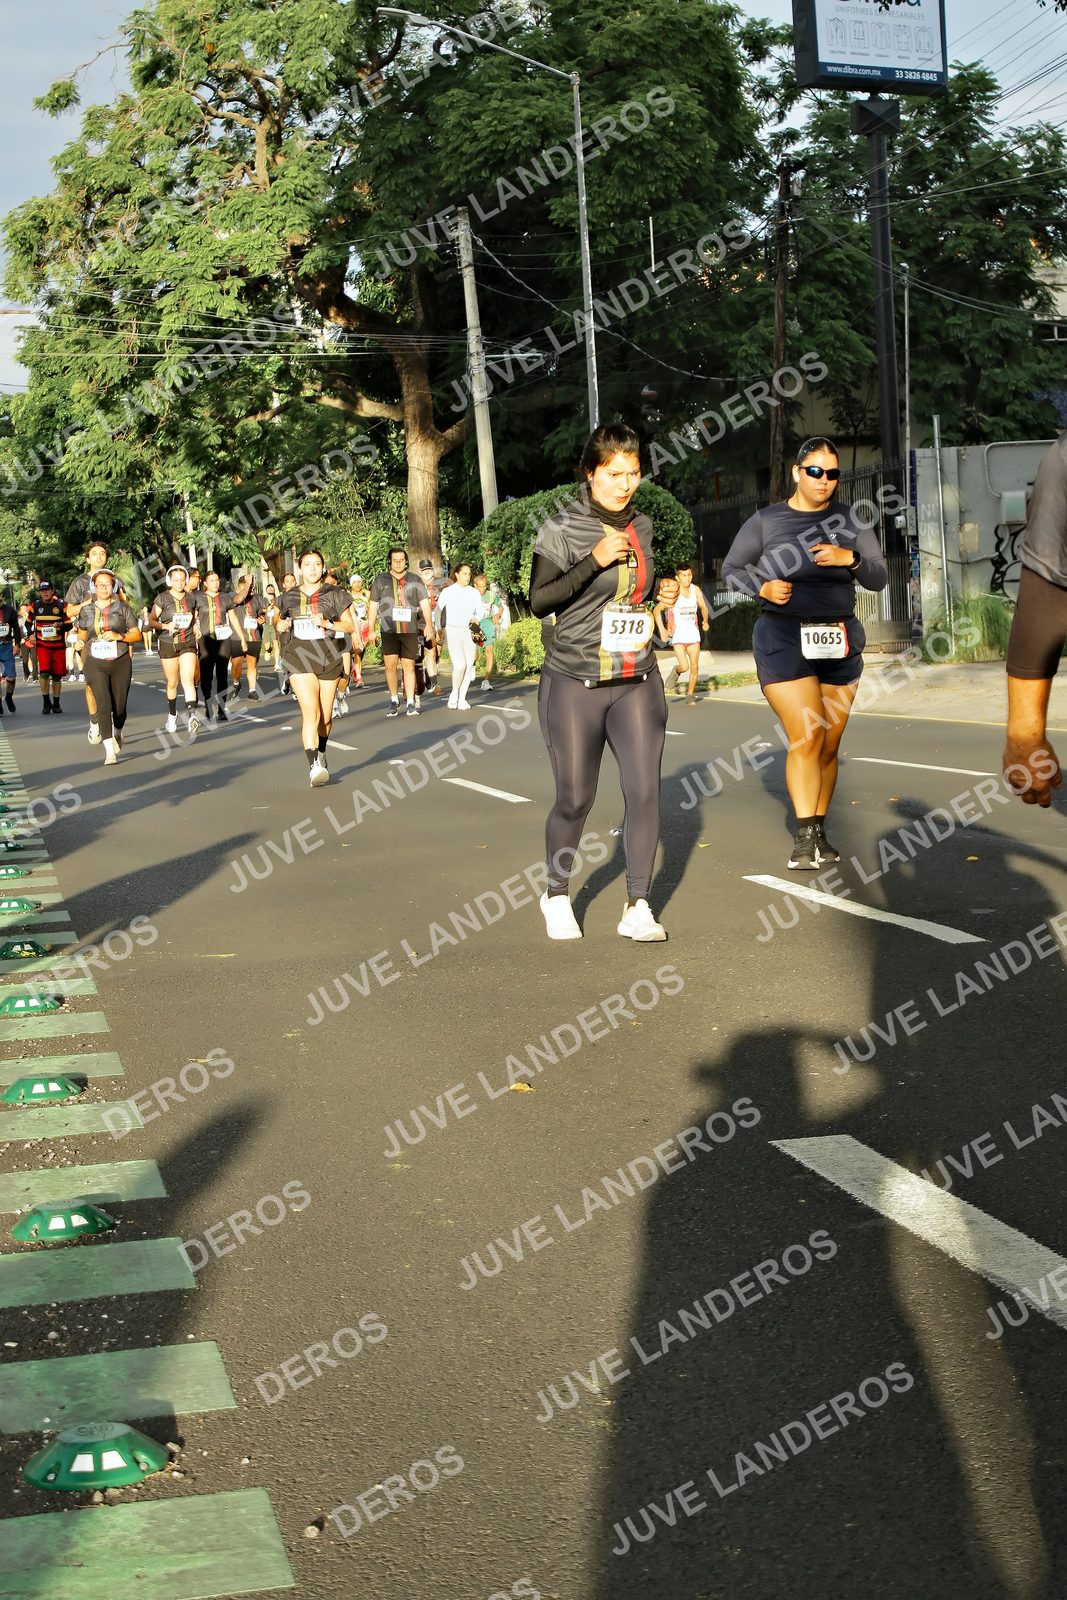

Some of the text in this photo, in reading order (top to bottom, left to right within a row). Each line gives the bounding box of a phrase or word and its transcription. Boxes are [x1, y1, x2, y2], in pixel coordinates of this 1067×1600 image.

[834, 5, 873, 16] UNIFORMES
[826, 65, 881, 76] www.dibra.com.mx
[895, 70, 938, 82] 33 3826 4845
[609, 619, 645, 635] 5318
[804, 631, 842, 645] 10655
